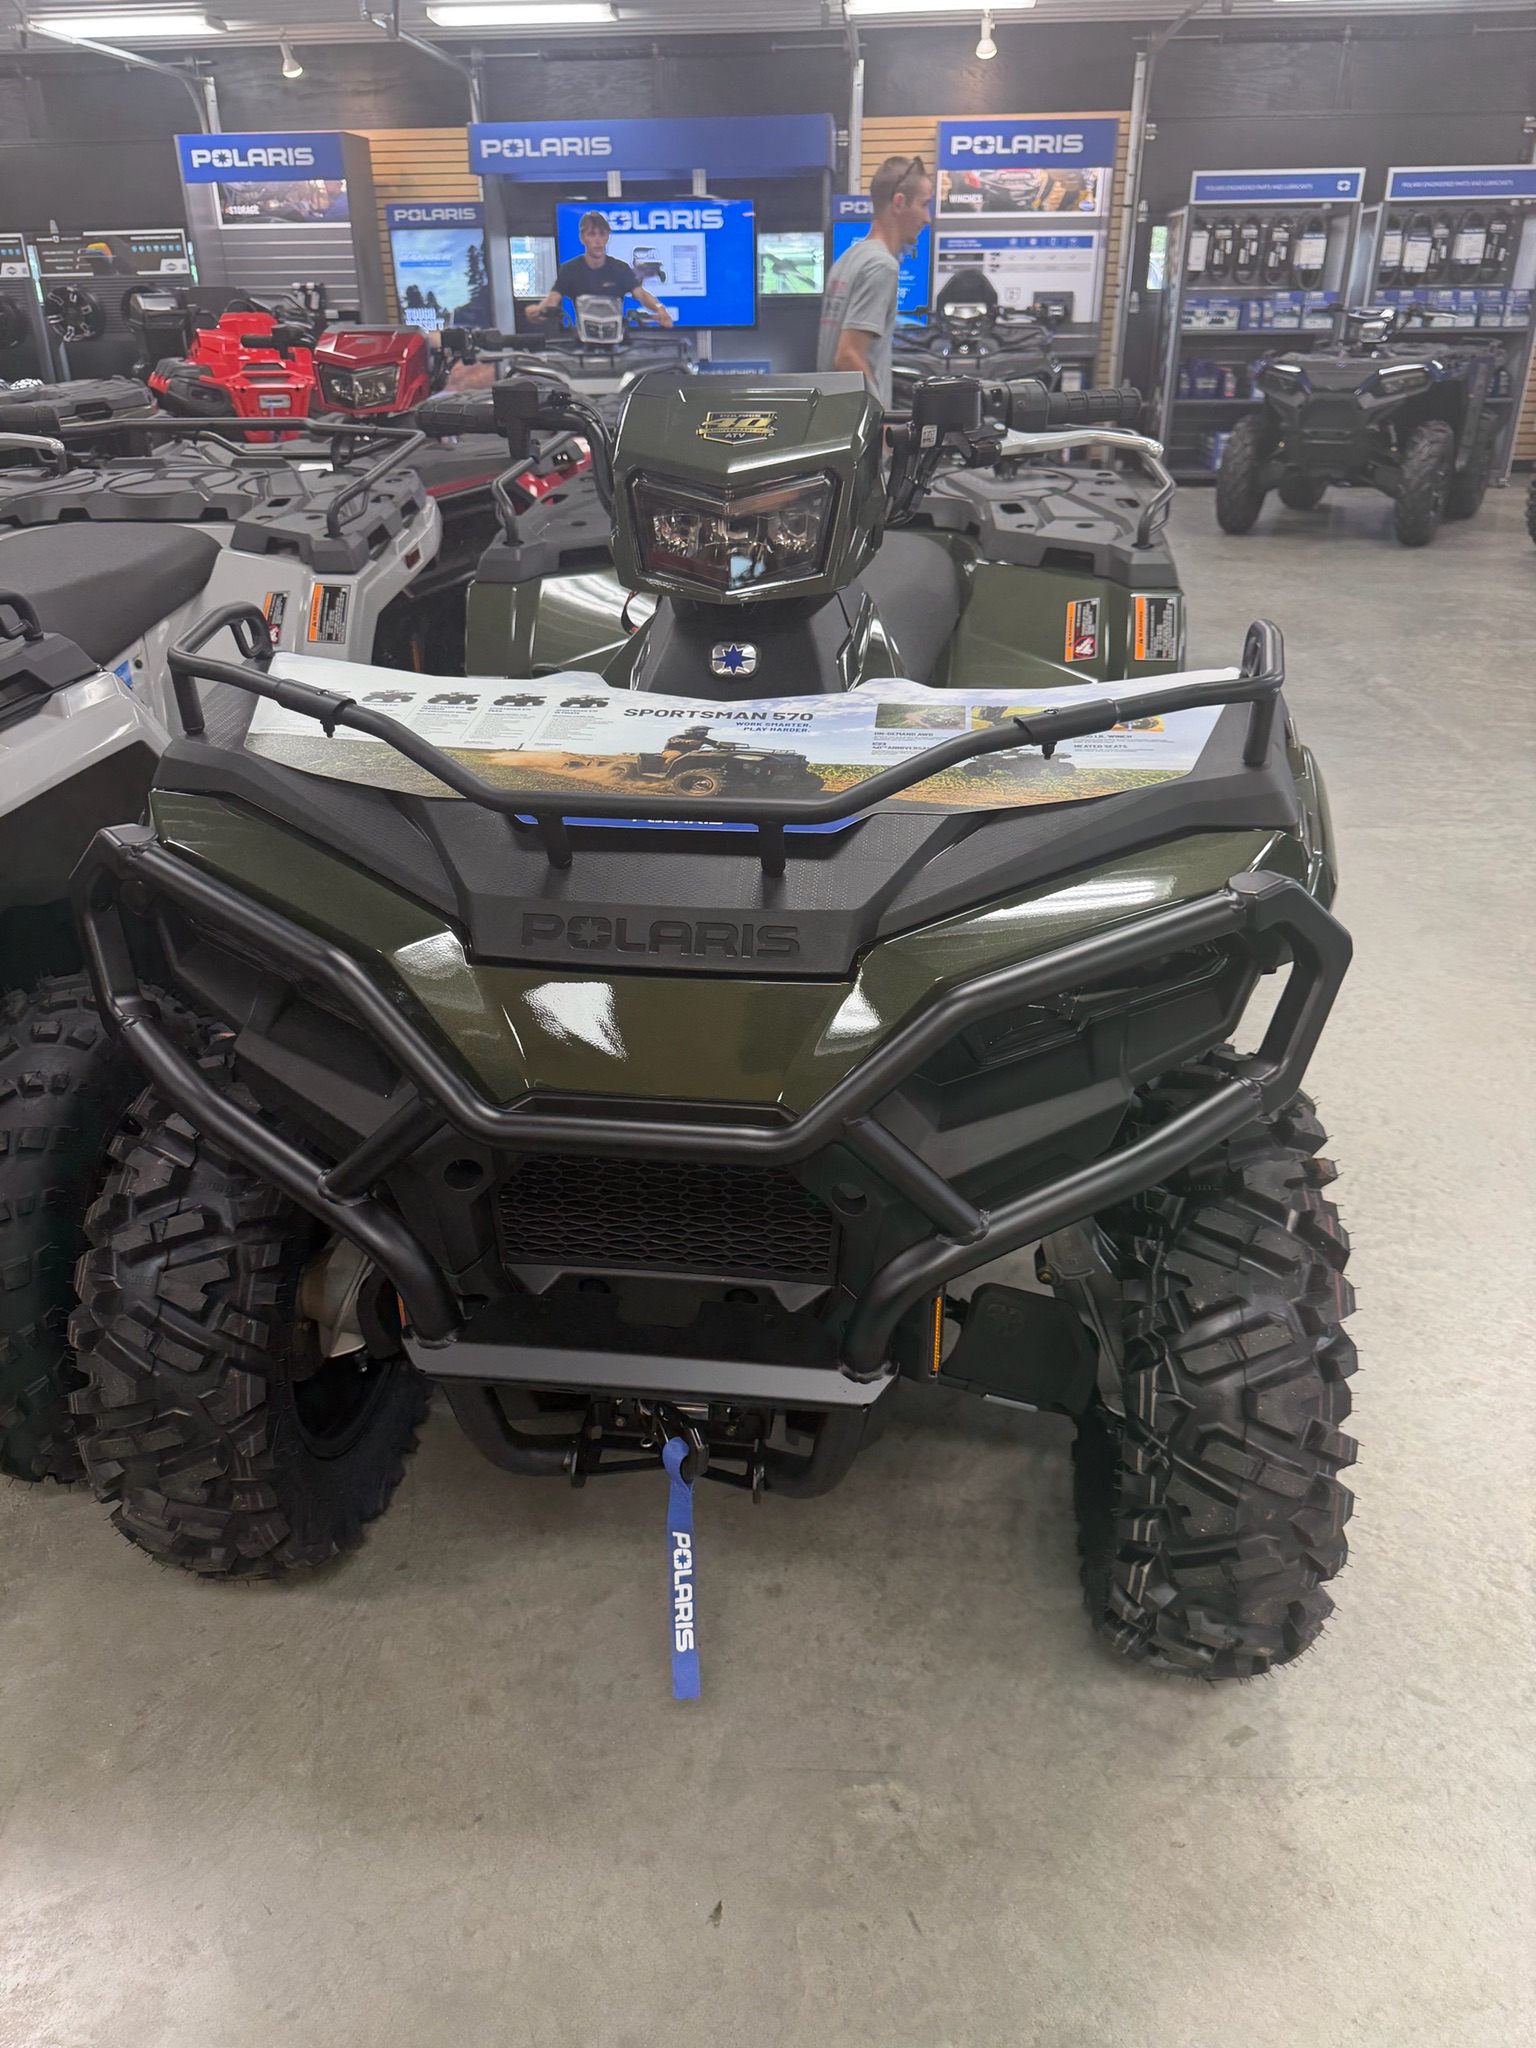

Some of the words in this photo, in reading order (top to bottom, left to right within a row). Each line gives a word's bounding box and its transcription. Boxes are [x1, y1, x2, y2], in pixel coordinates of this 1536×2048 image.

[480, 136, 613, 158] POLARIS
[950, 134, 1084, 155] POLARIS
[191, 147, 315, 168] POLARIS
[394, 208, 476, 221] POLARIS
[602, 208, 724, 231] OLARIS
[624, 708, 767, 721] SPORTSMAN
[772, 713, 814, 721] 570
[521, 913, 801, 958] POLARIS
[672, 1531, 695, 1653] POLARIS
